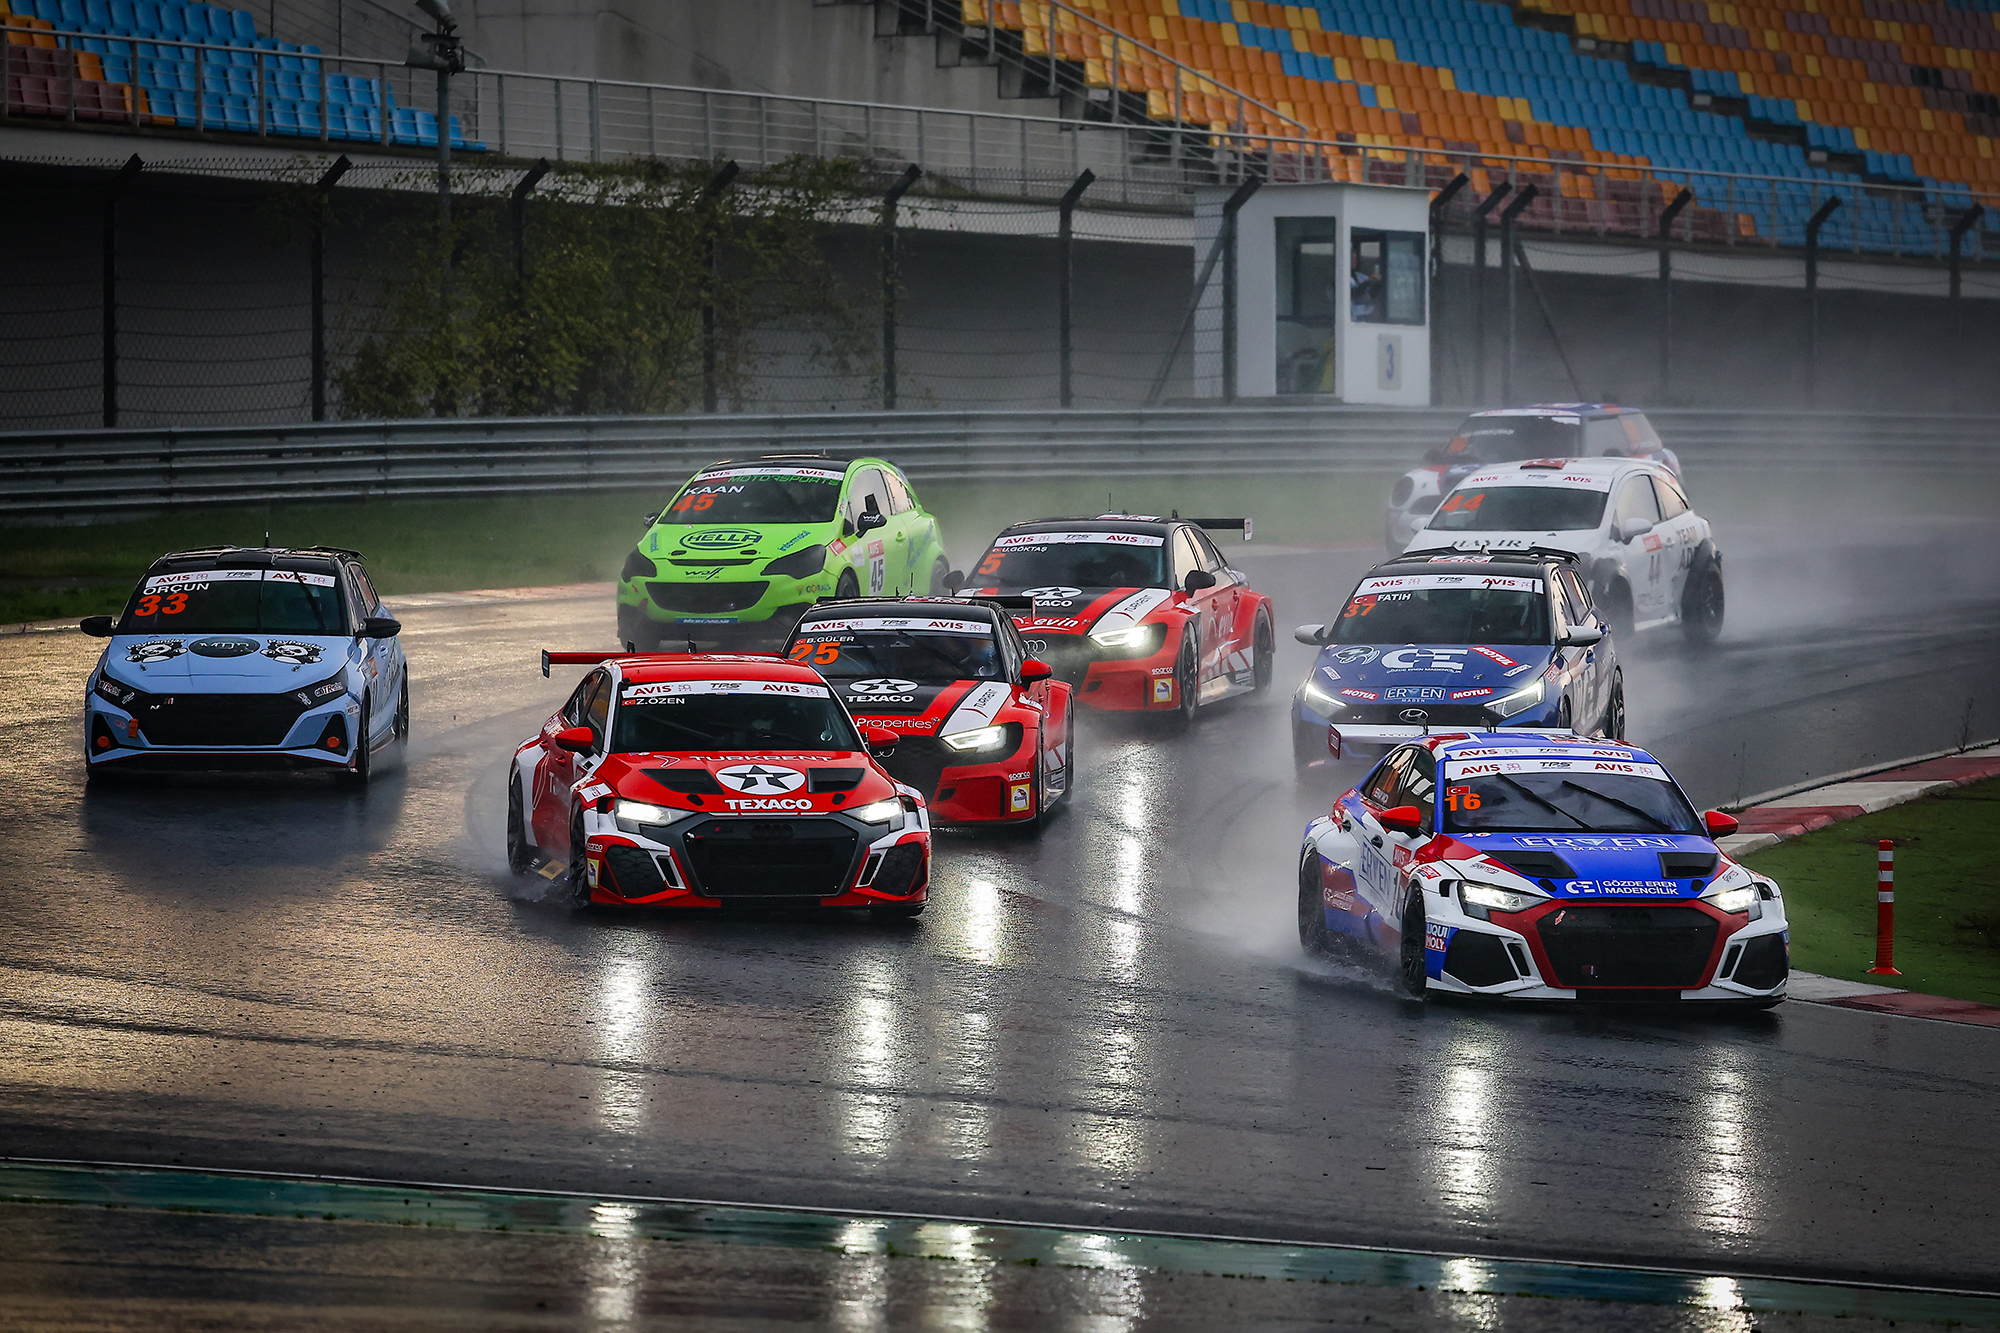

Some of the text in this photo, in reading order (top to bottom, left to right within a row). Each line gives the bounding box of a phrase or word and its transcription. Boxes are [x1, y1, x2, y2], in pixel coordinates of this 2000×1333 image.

[703, 471, 731, 479] AVIS
[796, 469, 825, 477] AVIS
[683, 485, 746, 497] KAAN
[672, 494, 718, 512] 45
[1441, 494, 1486, 513] 44
[687, 533, 763, 543] HELLA
[1004, 535, 1034, 545] AVIS
[1106, 534, 1139, 543] AVIS
[978, 553, 1007, 574] 5
[156, 574, 191, 584] AVIS
[871, 561, 884, 592] 45
[1370, 579, 1404, 588] AVIS
[1481, 578, 1516, 587] AVIS
[143, 583, 210, 595] ORÇUN
[1377, 593, 1412, 602] FATIH
[134, 593, 189, 617] 33
[1343, 603, 1377, 618] 37
[811, 621, 845, 631] AVIS
[928, 621, 964, 630] AVIS
[806, 635, 855, 644] B.GÜLER
[789, 642, 841, 665] 25
[1476, 646, 1516, 666] MOTUL
[634, 685, 673, 696] AVIS
[762, 684, 801, 693] AVIS
[1342, 689, 1377, 700] MOTUL
[1452, 689, 1491, 699] MOTUL
[636, 696, 685, 705] Z.ÖZEN
[846, 695, 914, 703] TEXACO
[856, 717, 933, 730] Properties
[1459, 749, 1498, 757] AVIS
[1593, 749, 1632, 758] AVIS
[1461, 763, 1501, 775] AVIS
[1540, 761, 1573, 769] TPS
[1595, 762, 1634, 773] AVIS
[1009, 771, 1031, 782] sparco
[724, 798, 813, 811] TEXACO
[1445, 792, 1481, 811] 16
[1603, 879, 1677, 889] GÖZDE EREN
[1604, 886, 1679, 896] MADENCİLİK
